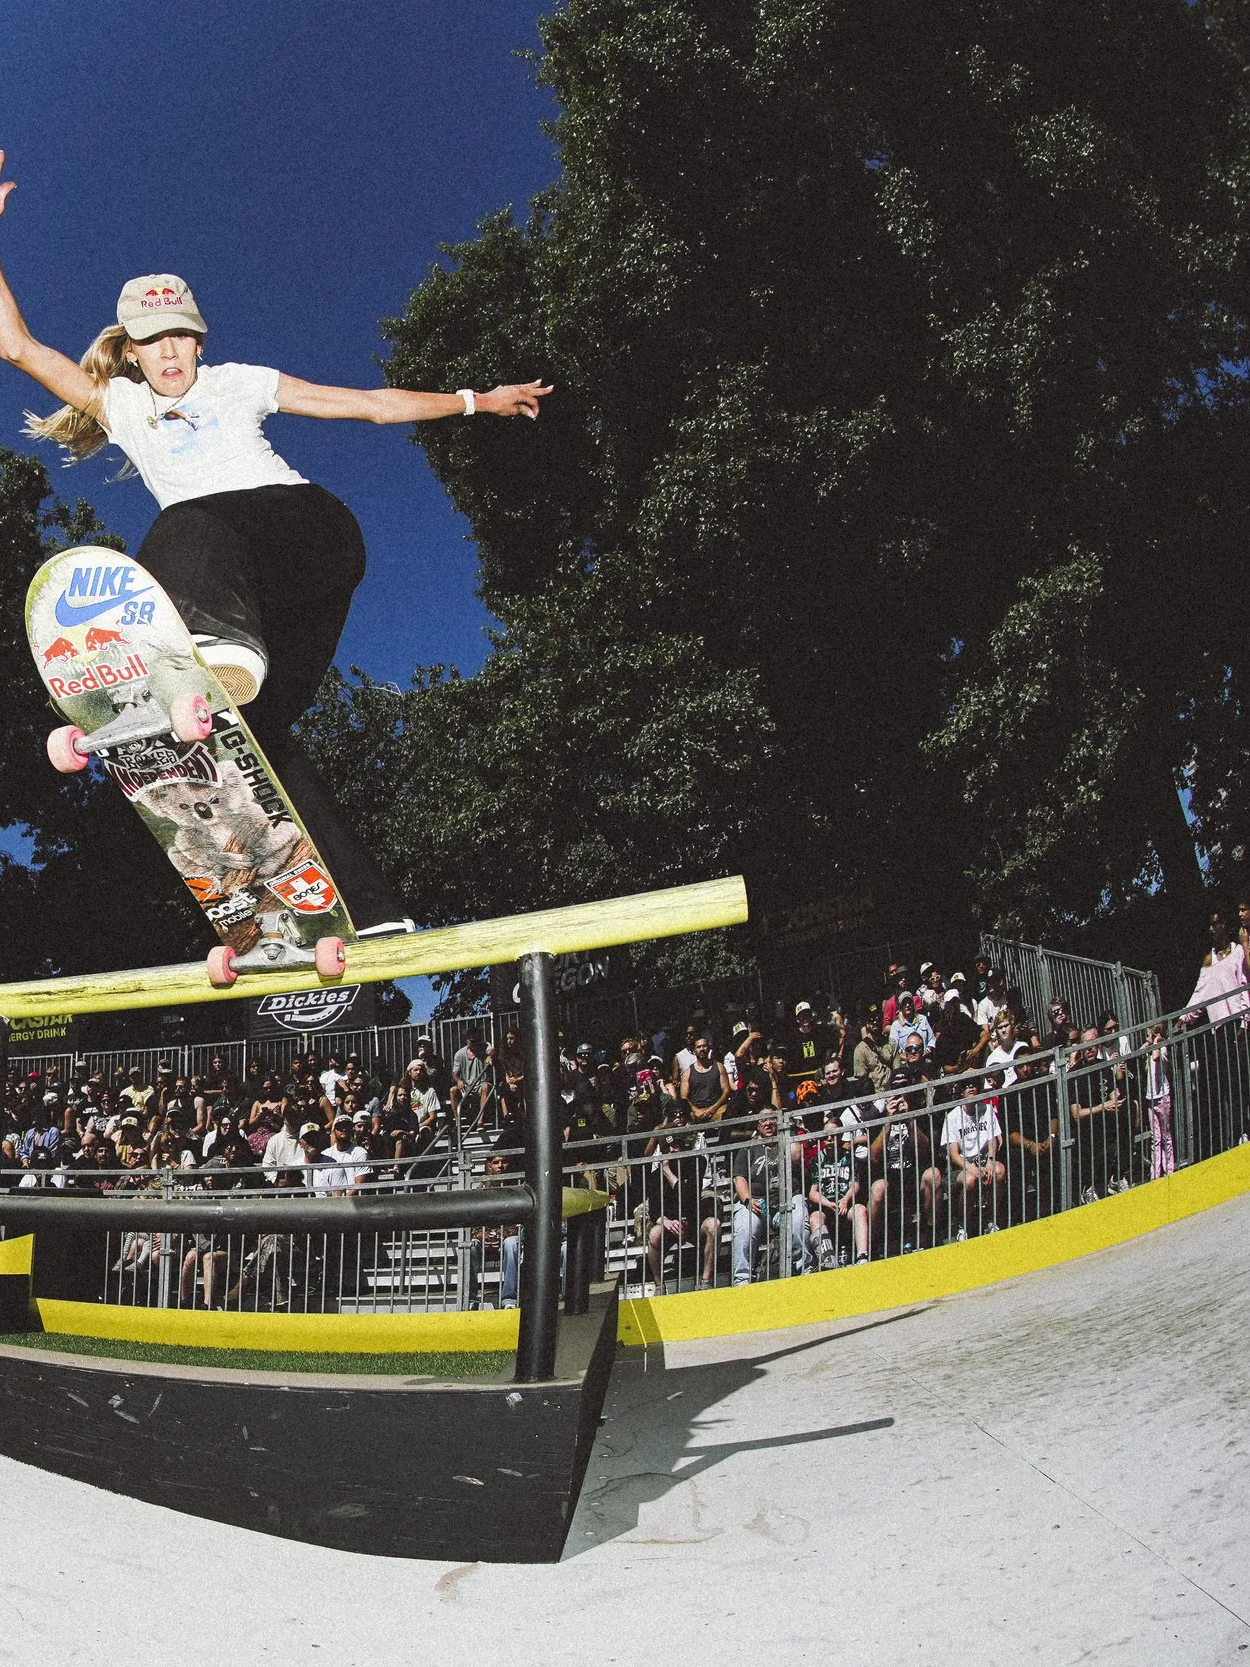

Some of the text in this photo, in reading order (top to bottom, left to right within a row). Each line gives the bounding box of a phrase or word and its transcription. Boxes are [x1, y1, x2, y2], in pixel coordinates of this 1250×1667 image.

[141, 296, 183, 308] Red Bull
[68, 566, 137, 597] NIKE
[48, 654, 148, 699] Red Bull
[107, 745, 218, 797] INDEPENDENT
[220, 729, 294, 829] G-SHOCK
[218, 908, 253, 928] mobile
[267, 990, 350, 1010] Dickies
[9, 1027, 67, 1042] ERGY DRINK
